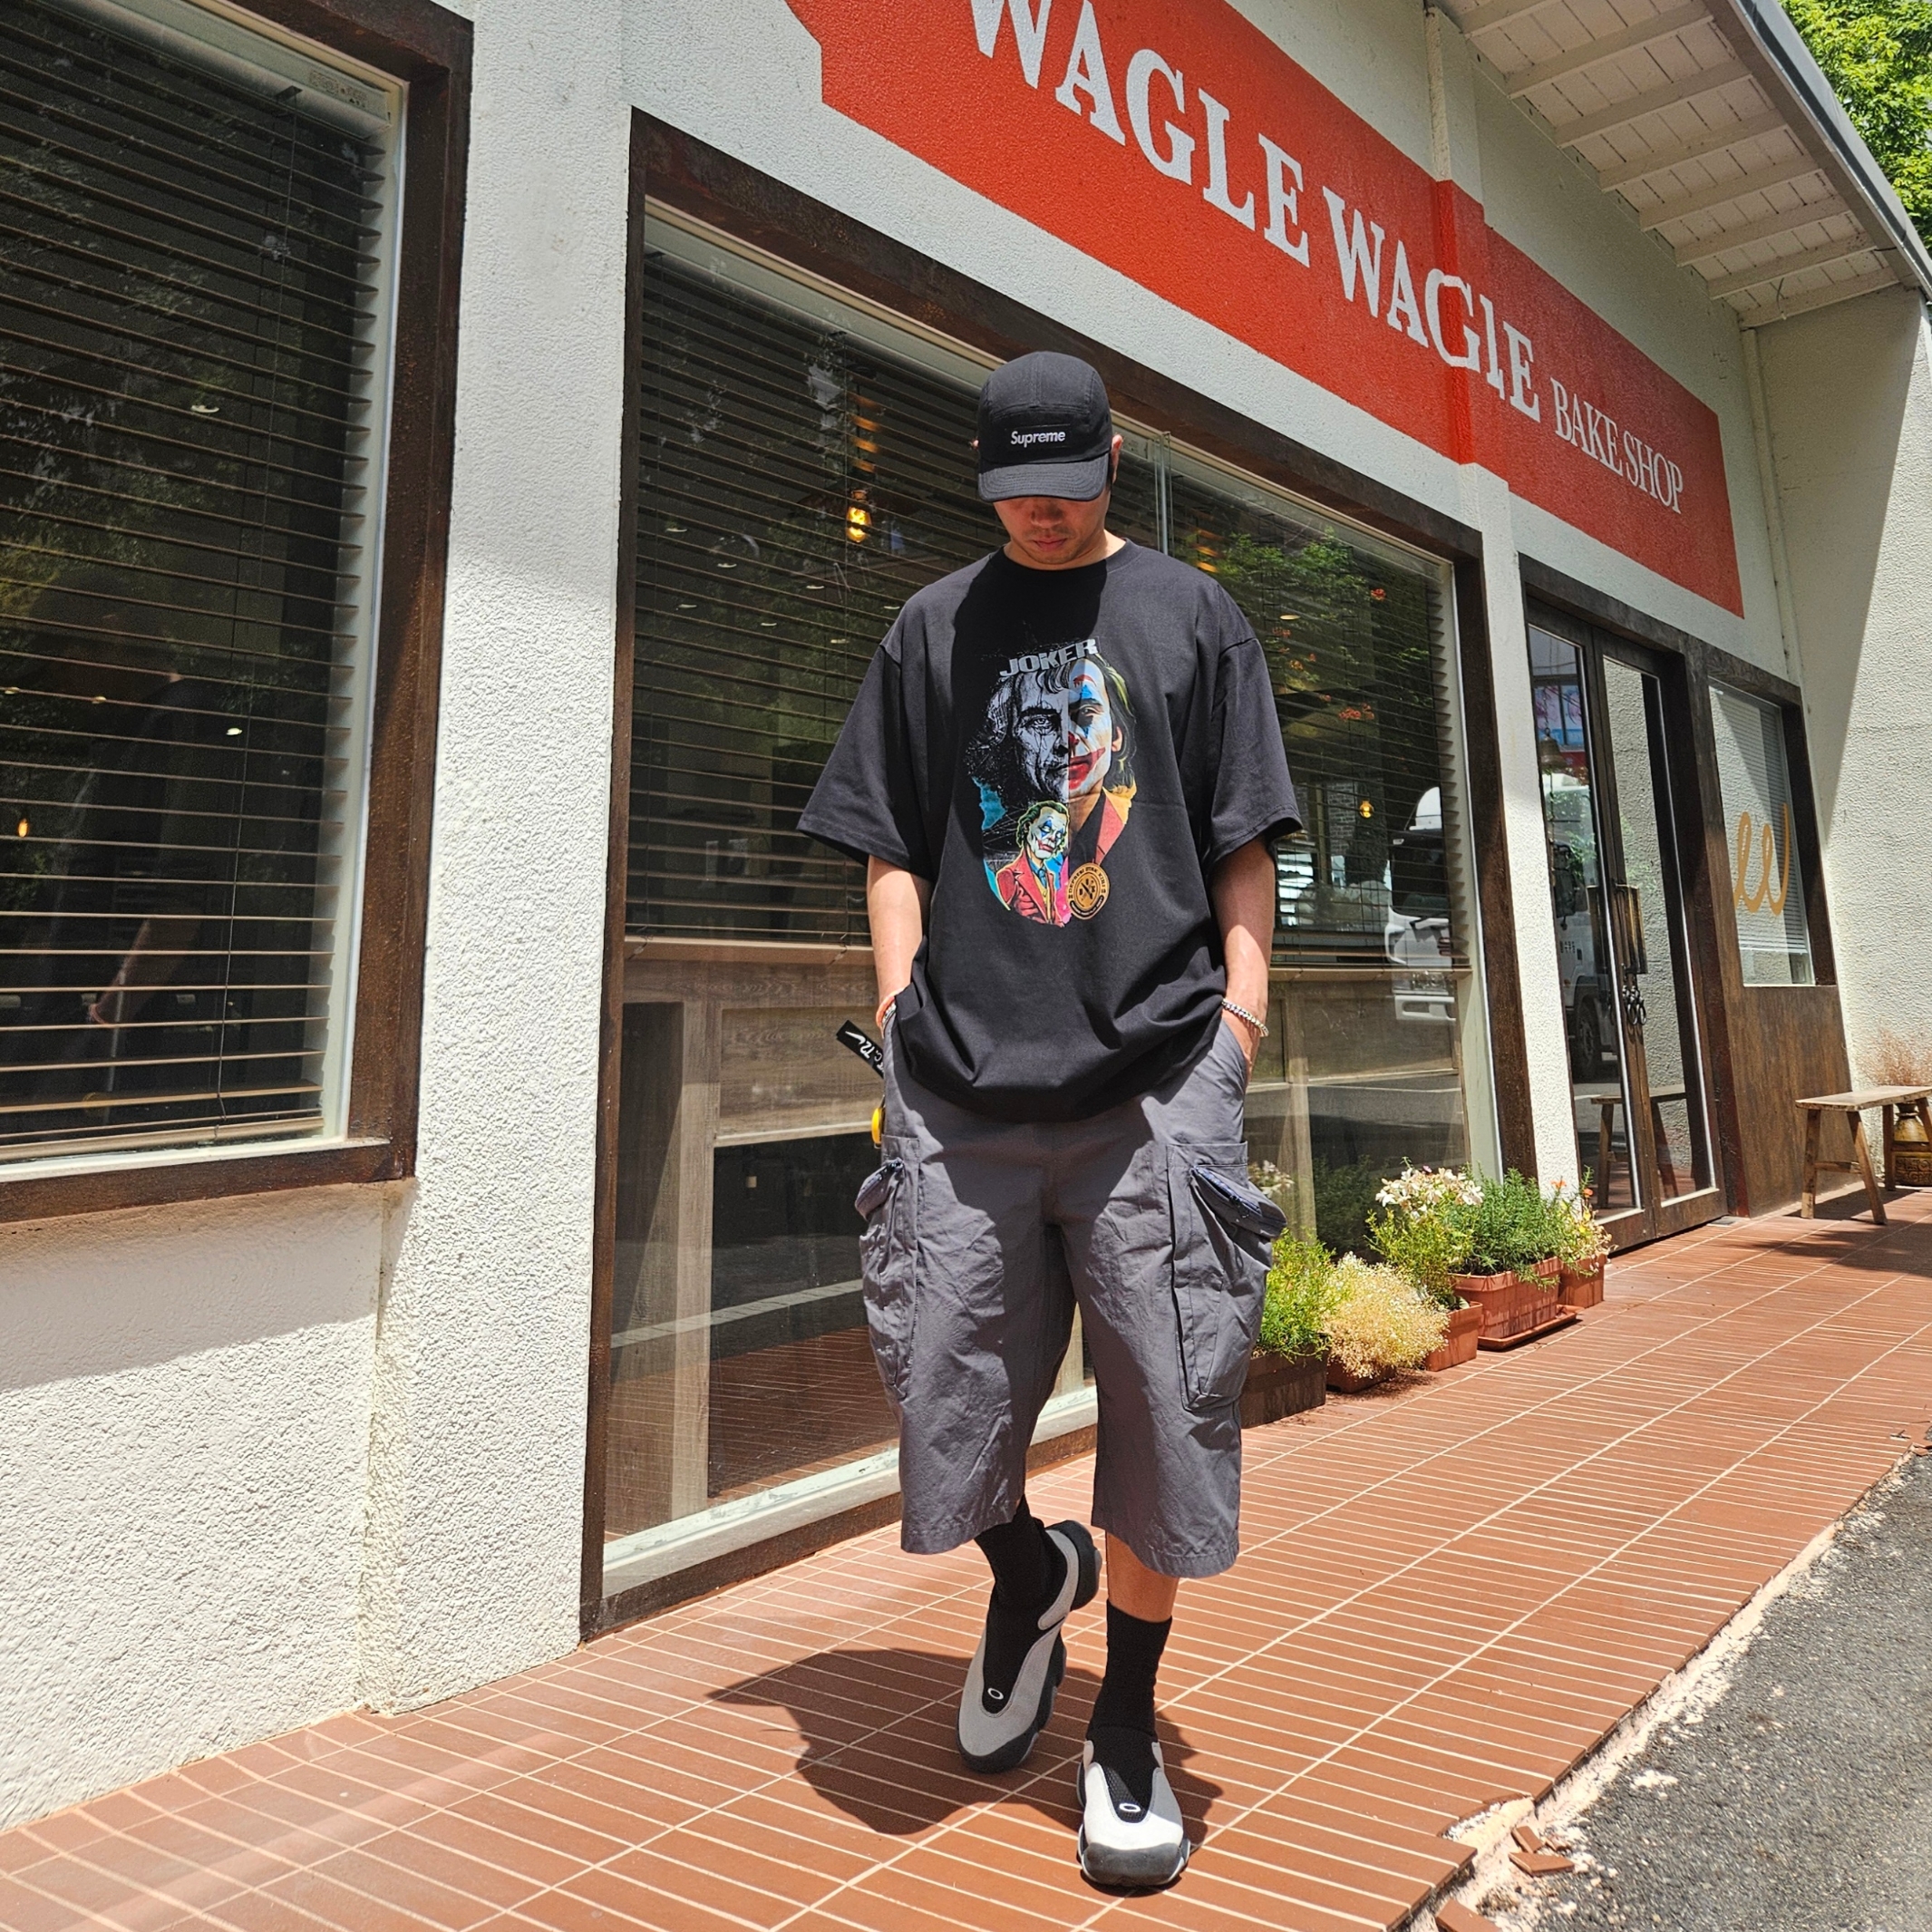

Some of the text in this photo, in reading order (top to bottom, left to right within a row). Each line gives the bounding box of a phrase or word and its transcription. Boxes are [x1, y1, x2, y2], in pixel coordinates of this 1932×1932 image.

[970, 0, 1684, 515] WAGLE WAGLE BAKE SHOP
[1010, 430, 1066, 448] Supreme
[999, 638, 1099, 677] JOKER
